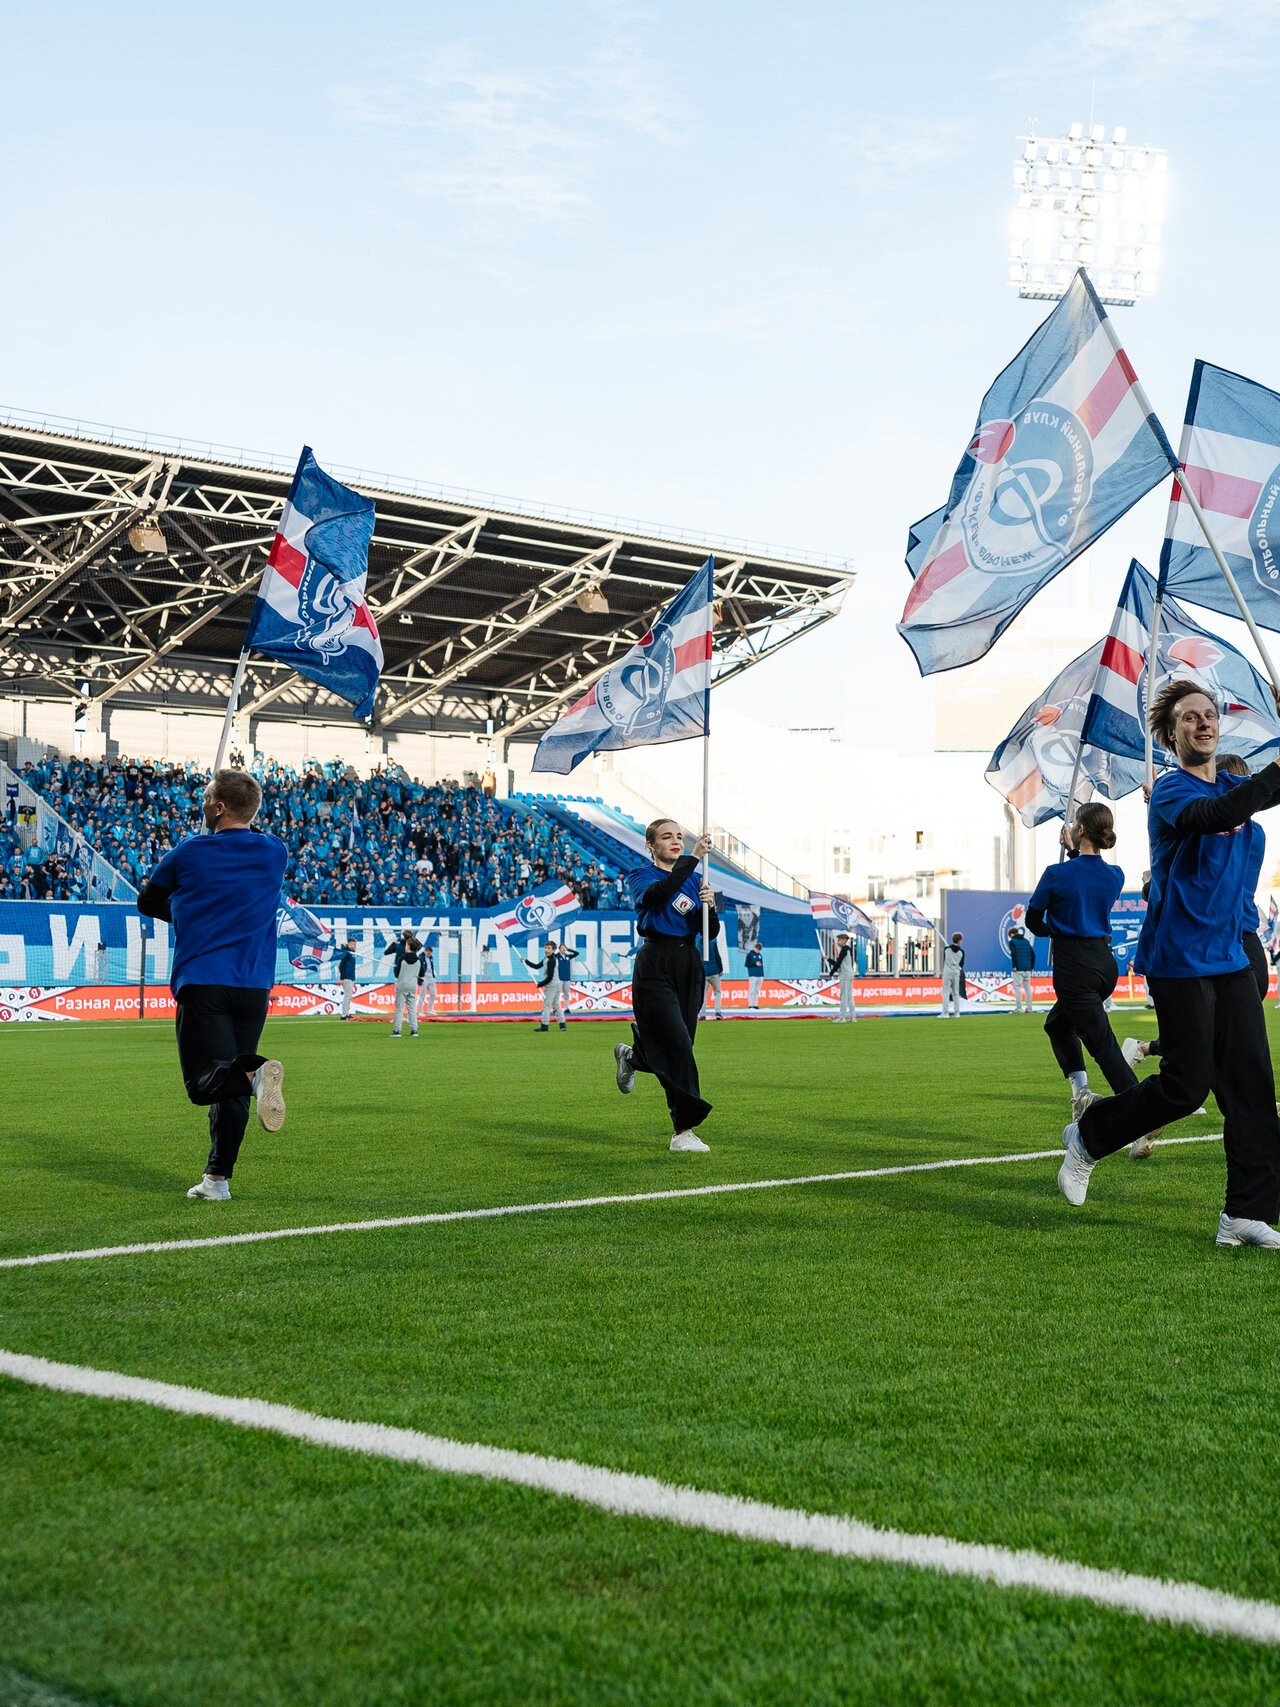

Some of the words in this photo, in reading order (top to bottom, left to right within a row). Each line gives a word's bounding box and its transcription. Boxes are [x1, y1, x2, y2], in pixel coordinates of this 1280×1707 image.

[1256, 484, 1280, 580] ФУТБОЛЬНЫЙ
[49, 914, 101, 980] И
[477, 993, 498, 1005] для
[766, 990, 796, 1001] задач
[863, 987, 902, 998] доставка
[905, 987, 922, 998] для
[55, 995, 99, 1011] Разная
[101, 997, 177, 1012] доставк
[276, 994, 316, 1008] задач
